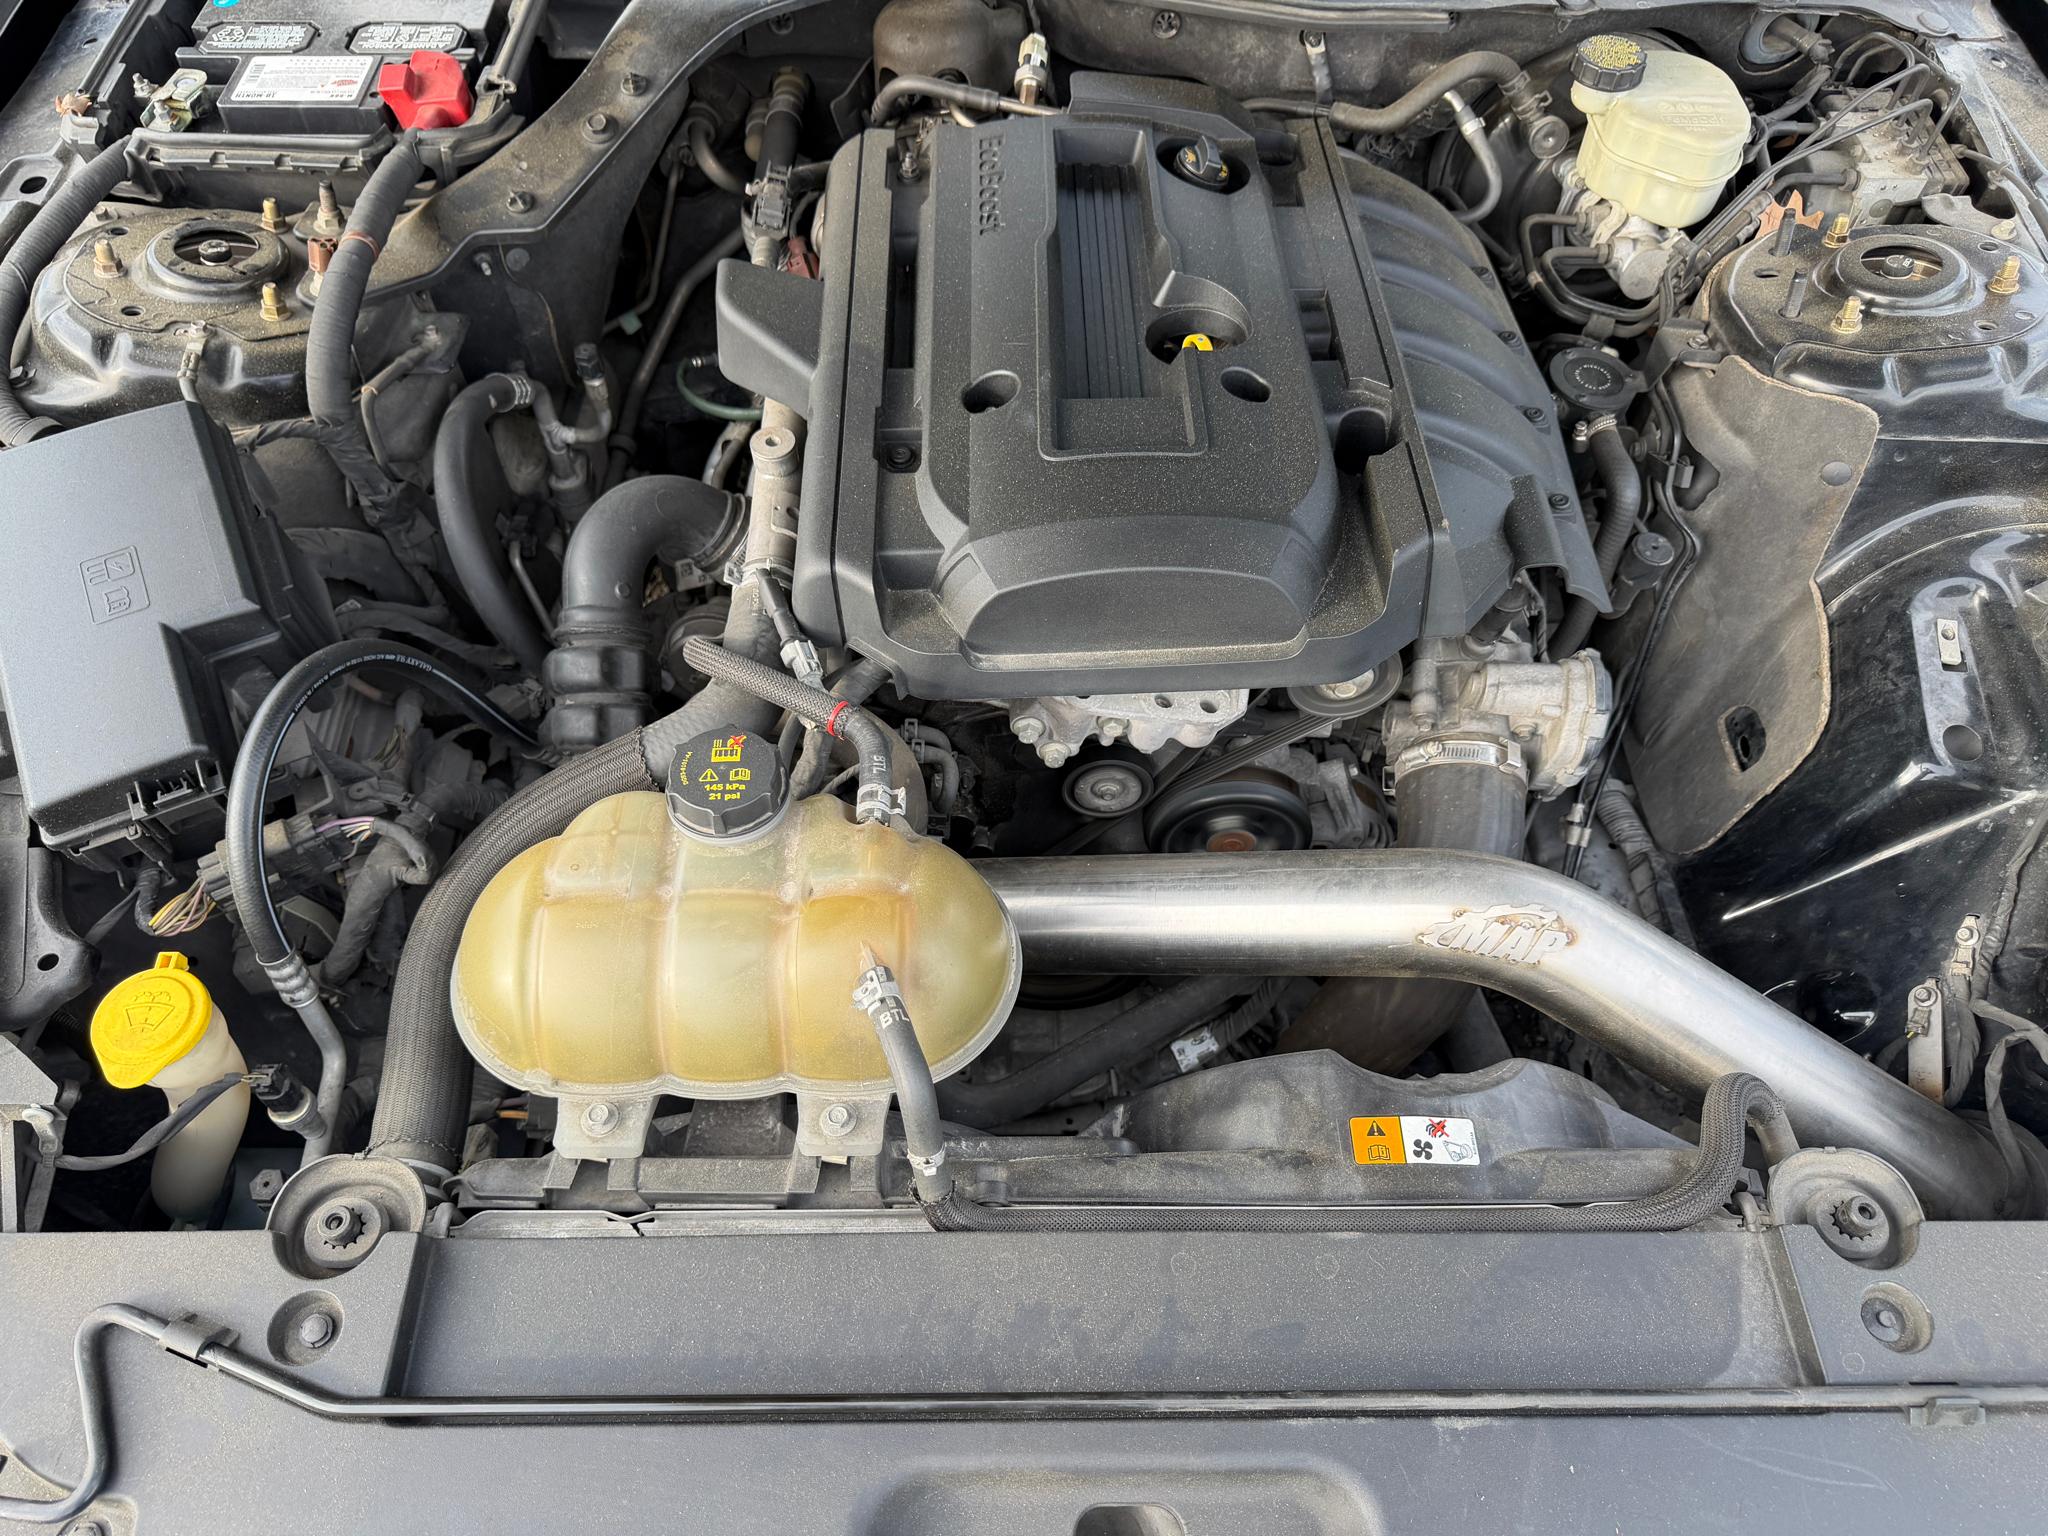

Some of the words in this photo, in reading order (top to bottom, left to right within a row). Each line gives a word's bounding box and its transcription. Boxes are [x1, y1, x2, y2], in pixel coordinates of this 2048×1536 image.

[979, 134, 1005, 236] EcoBoost
[405, 657, 432, 671] GALAXY
[704, 783, 724, 791] 145
[726, 783, 746, 791] kPa
[725, 792, 741, 801] psi
[880, 1008, 910, 1029] BTL
